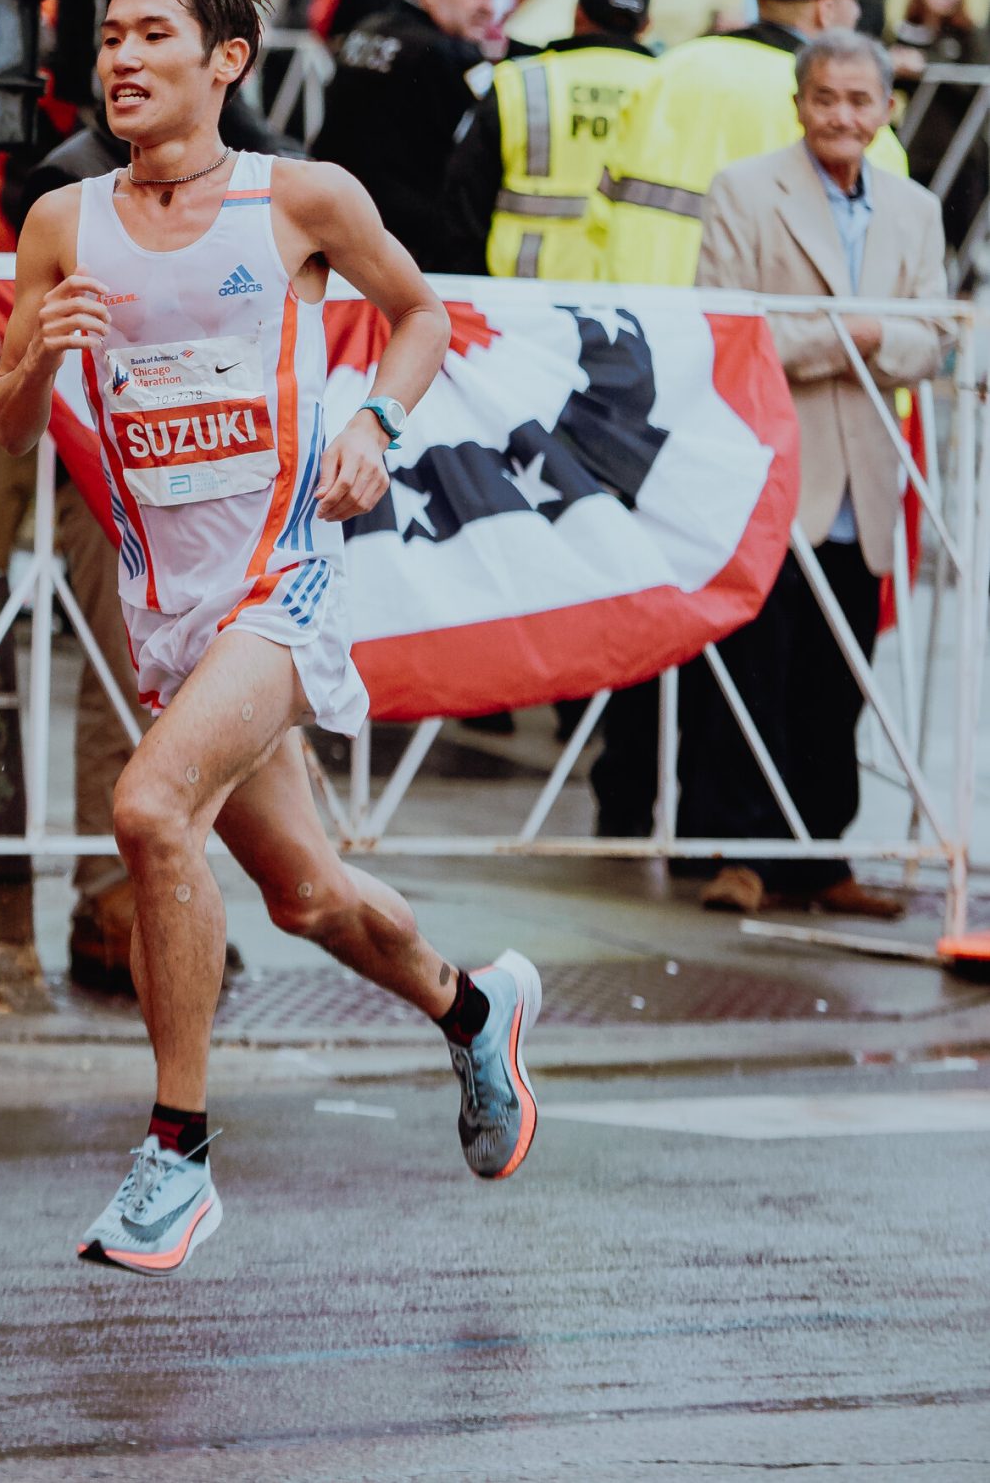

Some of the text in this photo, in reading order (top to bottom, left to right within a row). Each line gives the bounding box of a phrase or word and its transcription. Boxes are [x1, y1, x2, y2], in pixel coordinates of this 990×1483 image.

[218, 282, 263, 297] adidas
[154, 355, 179, 363] America
[132, 366, 171, 377] Chicago
[134, 375, 182, 388] Marathon
[125, 408, 258, 460] SUZUKI
